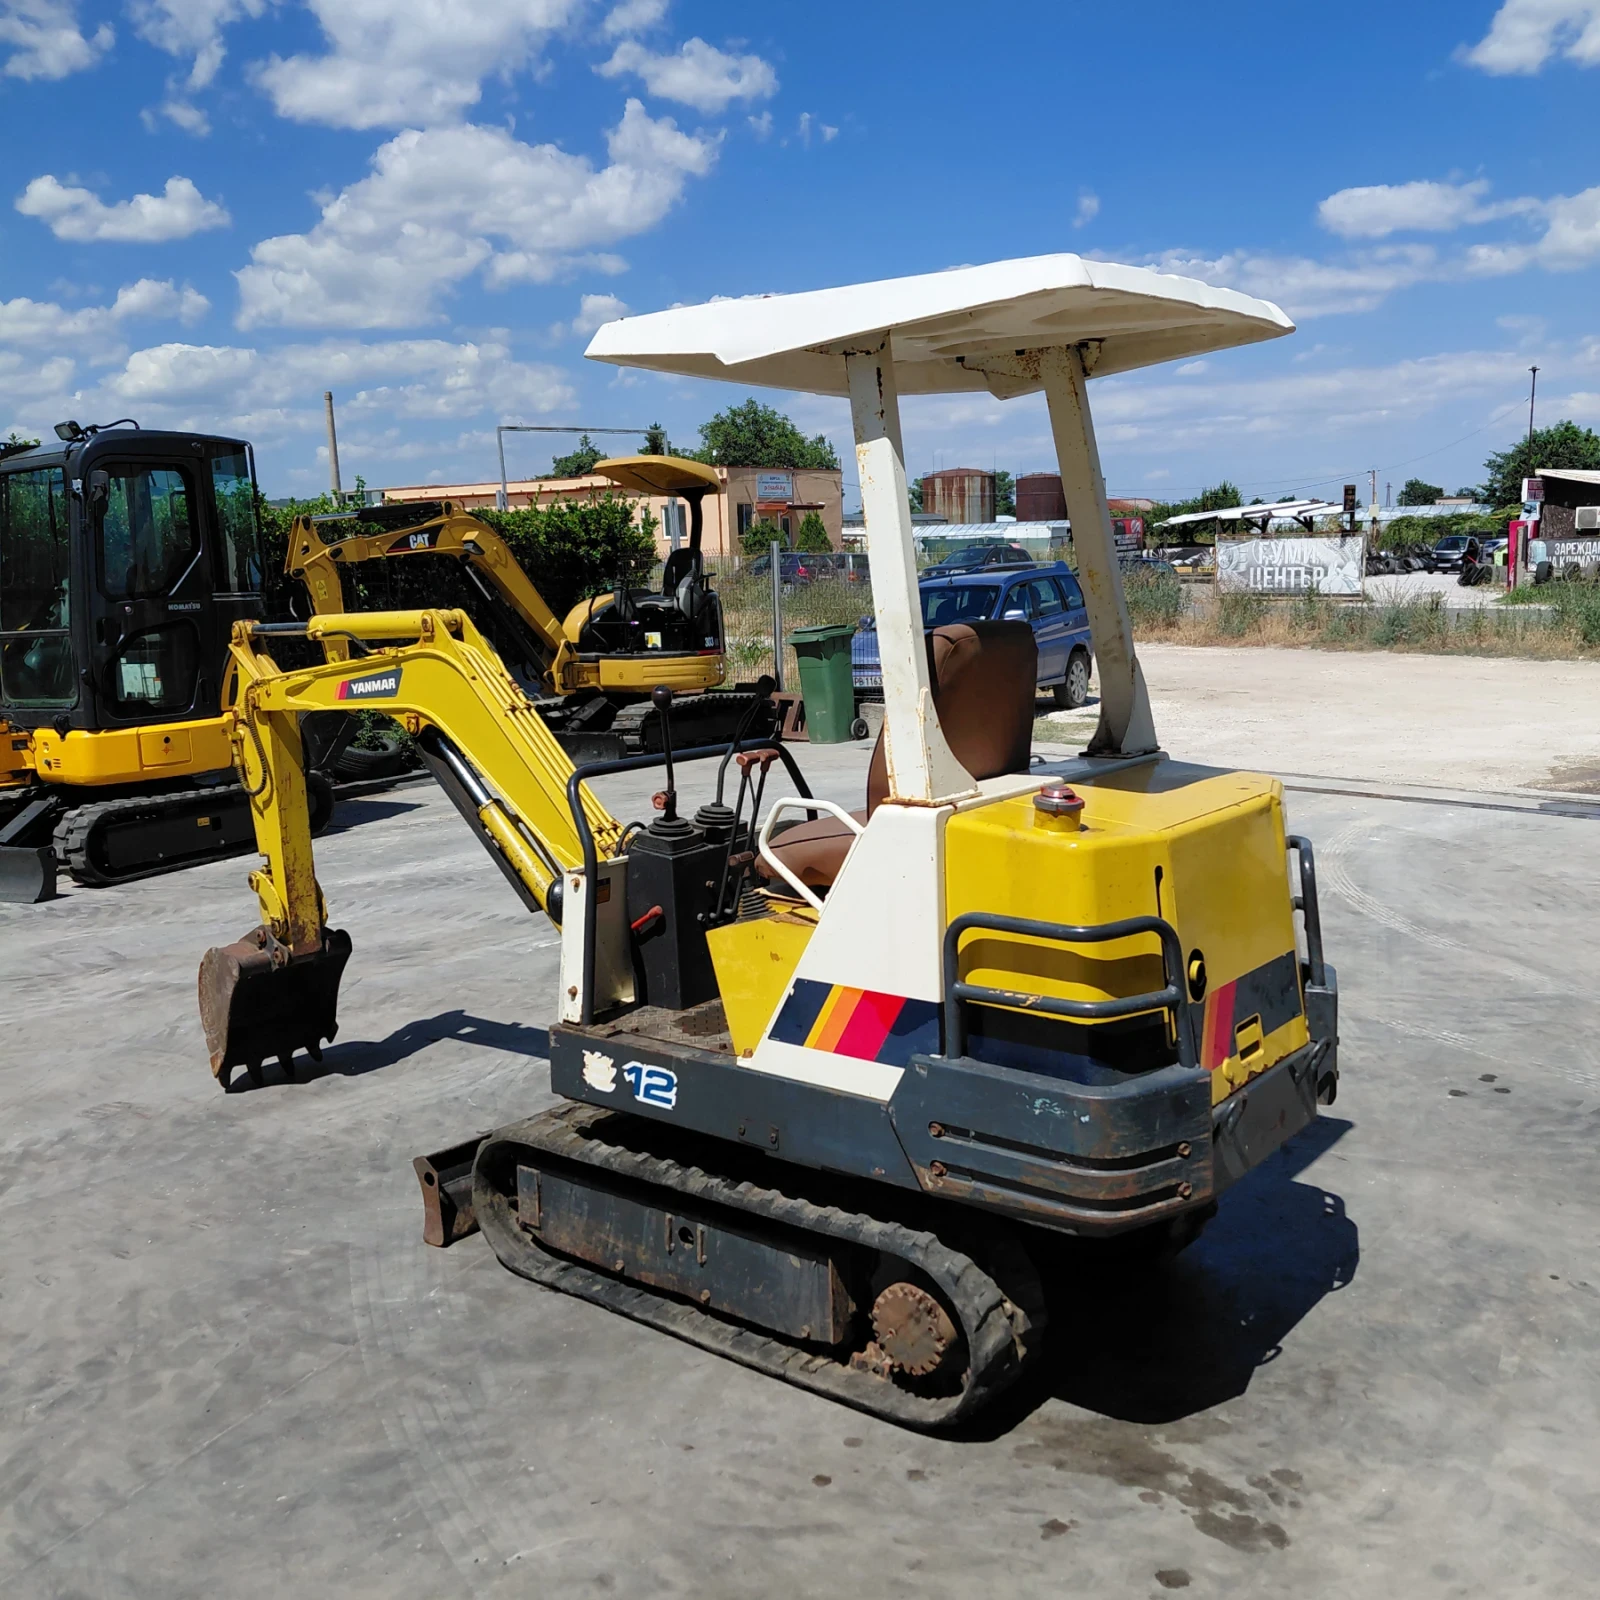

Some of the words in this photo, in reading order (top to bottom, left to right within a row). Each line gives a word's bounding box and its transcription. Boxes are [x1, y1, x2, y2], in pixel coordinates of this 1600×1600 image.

[409, 533, 430, 549] CAT
[1554, 541, 1600, 556] ЗАРЕЖДА
[1259, 539, 1320, 566] ГУМИ
[1250, 566, 1325, 590] ЦЕНТЪР
[168, 601, 201, 611] KOMATSU
[350, 677, 396, 695] YANMAR
[623, 1062, 677, 1109] 12
